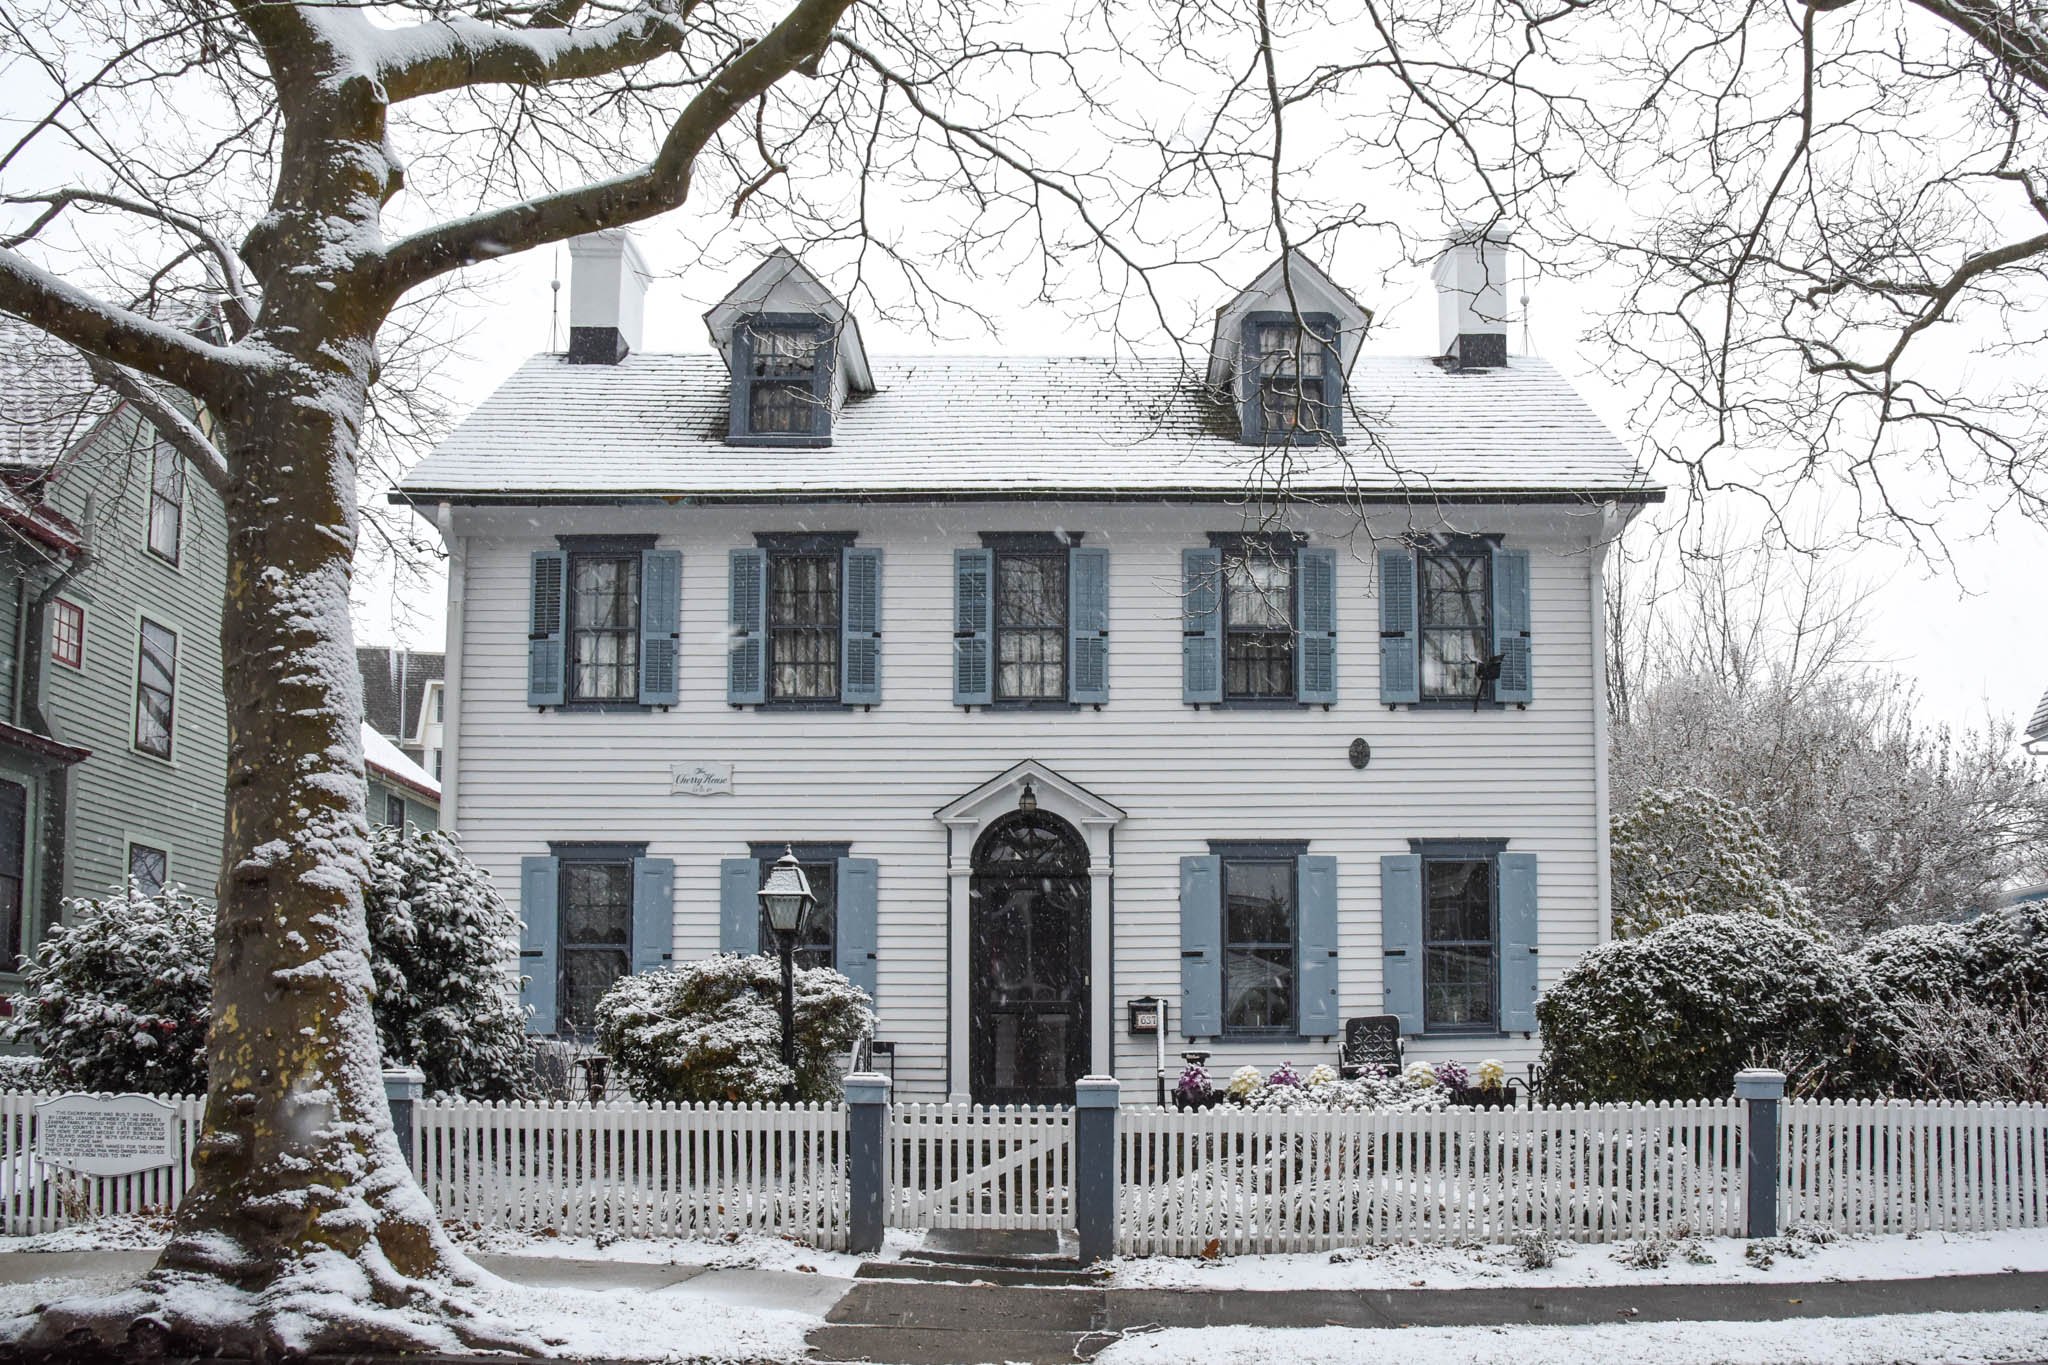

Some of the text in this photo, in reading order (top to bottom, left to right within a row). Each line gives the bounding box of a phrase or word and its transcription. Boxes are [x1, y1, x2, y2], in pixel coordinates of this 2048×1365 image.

[675, 774, 727, 785] Cherry House
[1140, 1015, 1156, 1024] 637
